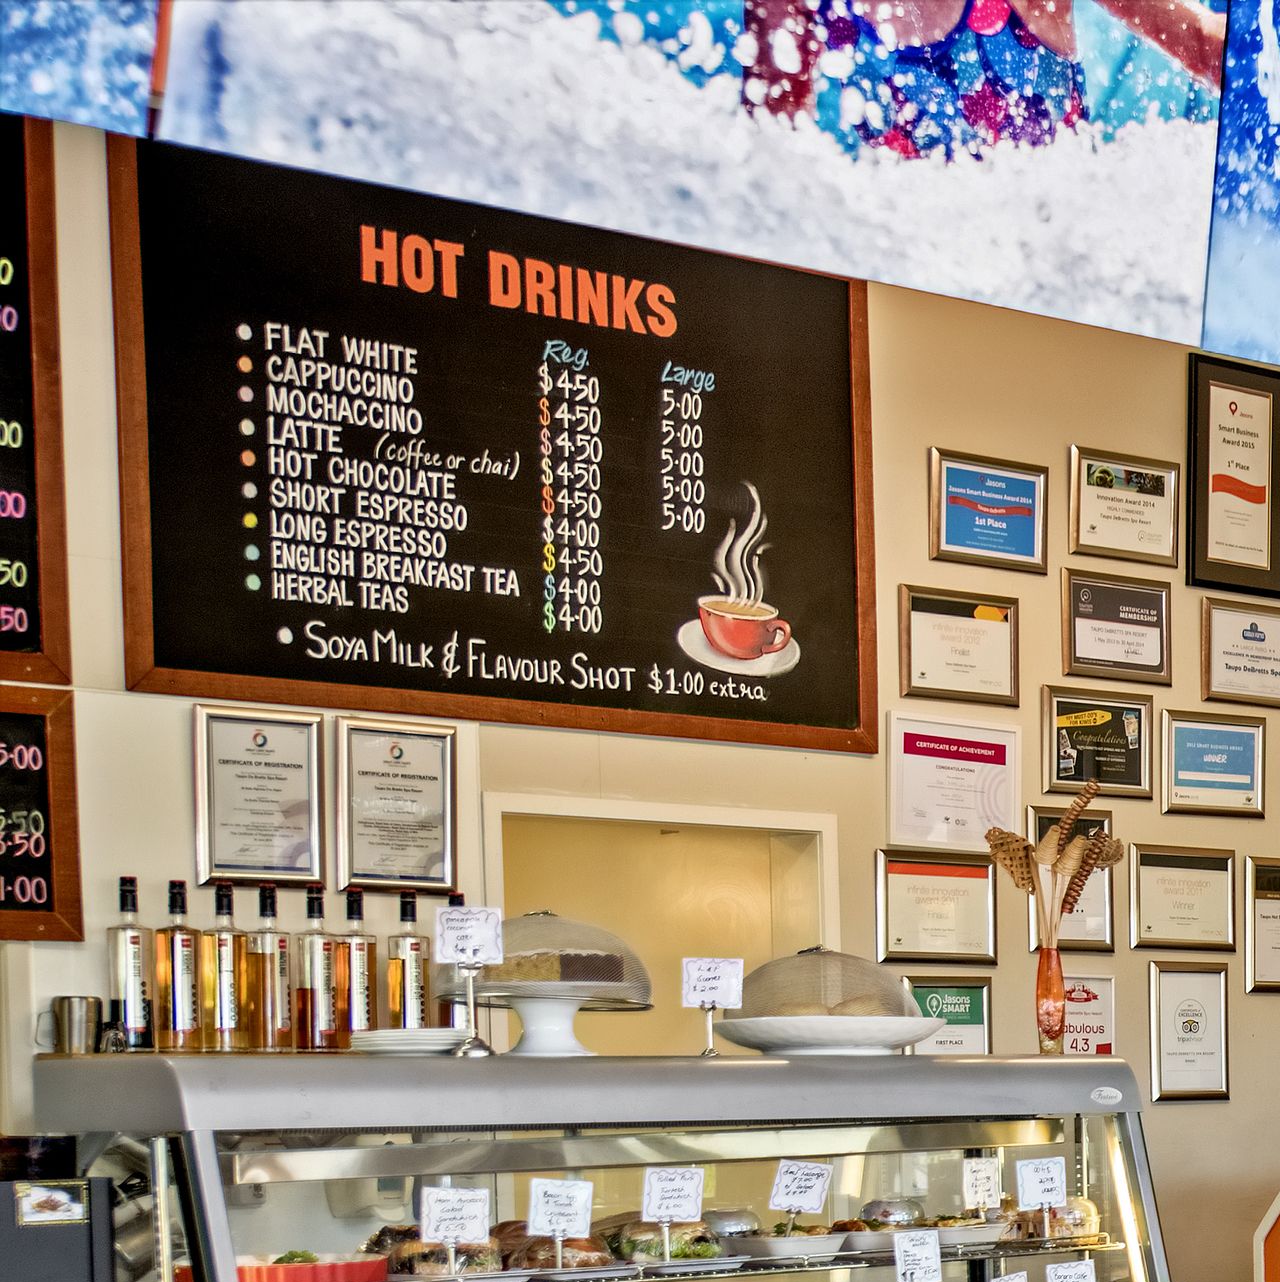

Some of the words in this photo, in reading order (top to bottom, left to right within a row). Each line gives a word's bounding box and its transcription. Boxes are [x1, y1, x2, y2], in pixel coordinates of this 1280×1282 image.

[360, 224, 464, 298] HOT
[488, 250, 677, 338] DRINKS
[264, 321, 329, 358] FLAT
[341, 335, 418, 375] WHITE
[543, 340, 589, 371] Reg.
[266, 354, 414, 403] CAPPUCCINO
[661, 361, 715, 392] Large
[266, 383, 423, 434] MOCHACCINO
[1218, 423, 1235, 434] Smart
[1236, 427, 1259, 438] Business
[267, 415, 342, 452] LATTE
[375, 433, 441, 470] (coffee
[447, 454, 465, 470] or
[471, 449, 520, 480] chai)
[1222, 437, 1240, 447] Award
[268, 446, 318, 479] HOT
[329, 456, 456, 500] CHOCOLATE
[1235, 462, 1250, 471] Place
[985, 478, 1006, 489] Jasons
[967, 488, 981, 496] Smart
[982, 491, 1003, 499] Business
[1003, 494, 1019, 502] Award
[1020, 496, 1032, 504] 2014
[1097, 493, 1124, 503] Innovation
[1125, 498, 1141, 506] Award
[1143, 500, 1155, 508] 2014
[269, 478, 346, 514] SHORT
[356, 492, 467, 530] ESPRESSO
[975, 516, 986, 526] 1st
[987, 518, 1007, 529] Place
[270, 510, 327, 544] LONG
[334, 518, 447, 558] ESPRESSO
[271, 541, 354, 577] ENGLISH
[362, 552, 475, 593] BREAKFAST
[482, 567, 520, 597] TEA
[271, 571, 353, 607] HERBAL
[358, 581, 409, 613] TEAS
[1119, 605, 1149, 614] CERTIFICATE
[1119, 611, 1157, 622] MEMBERSHIP
[1224, 663, 1242, 673] Taupo
[709, 676, 768, 702] extra
[915, 741, 950, 751] CERTIFICATE
[958, 746, 995, 756] ACHIEVEMENT
[218, 758, 253, 767] CERTIFICATE
[357, 770, 390, 778] CERTIFICATE
[943, 994, 970, 1004] Jasons
[943, 1003, 970, 1013] SMART
[1063, 1023, 1105, 1034] abulous
[1070, 1038, 1090, 1053] 4.3
